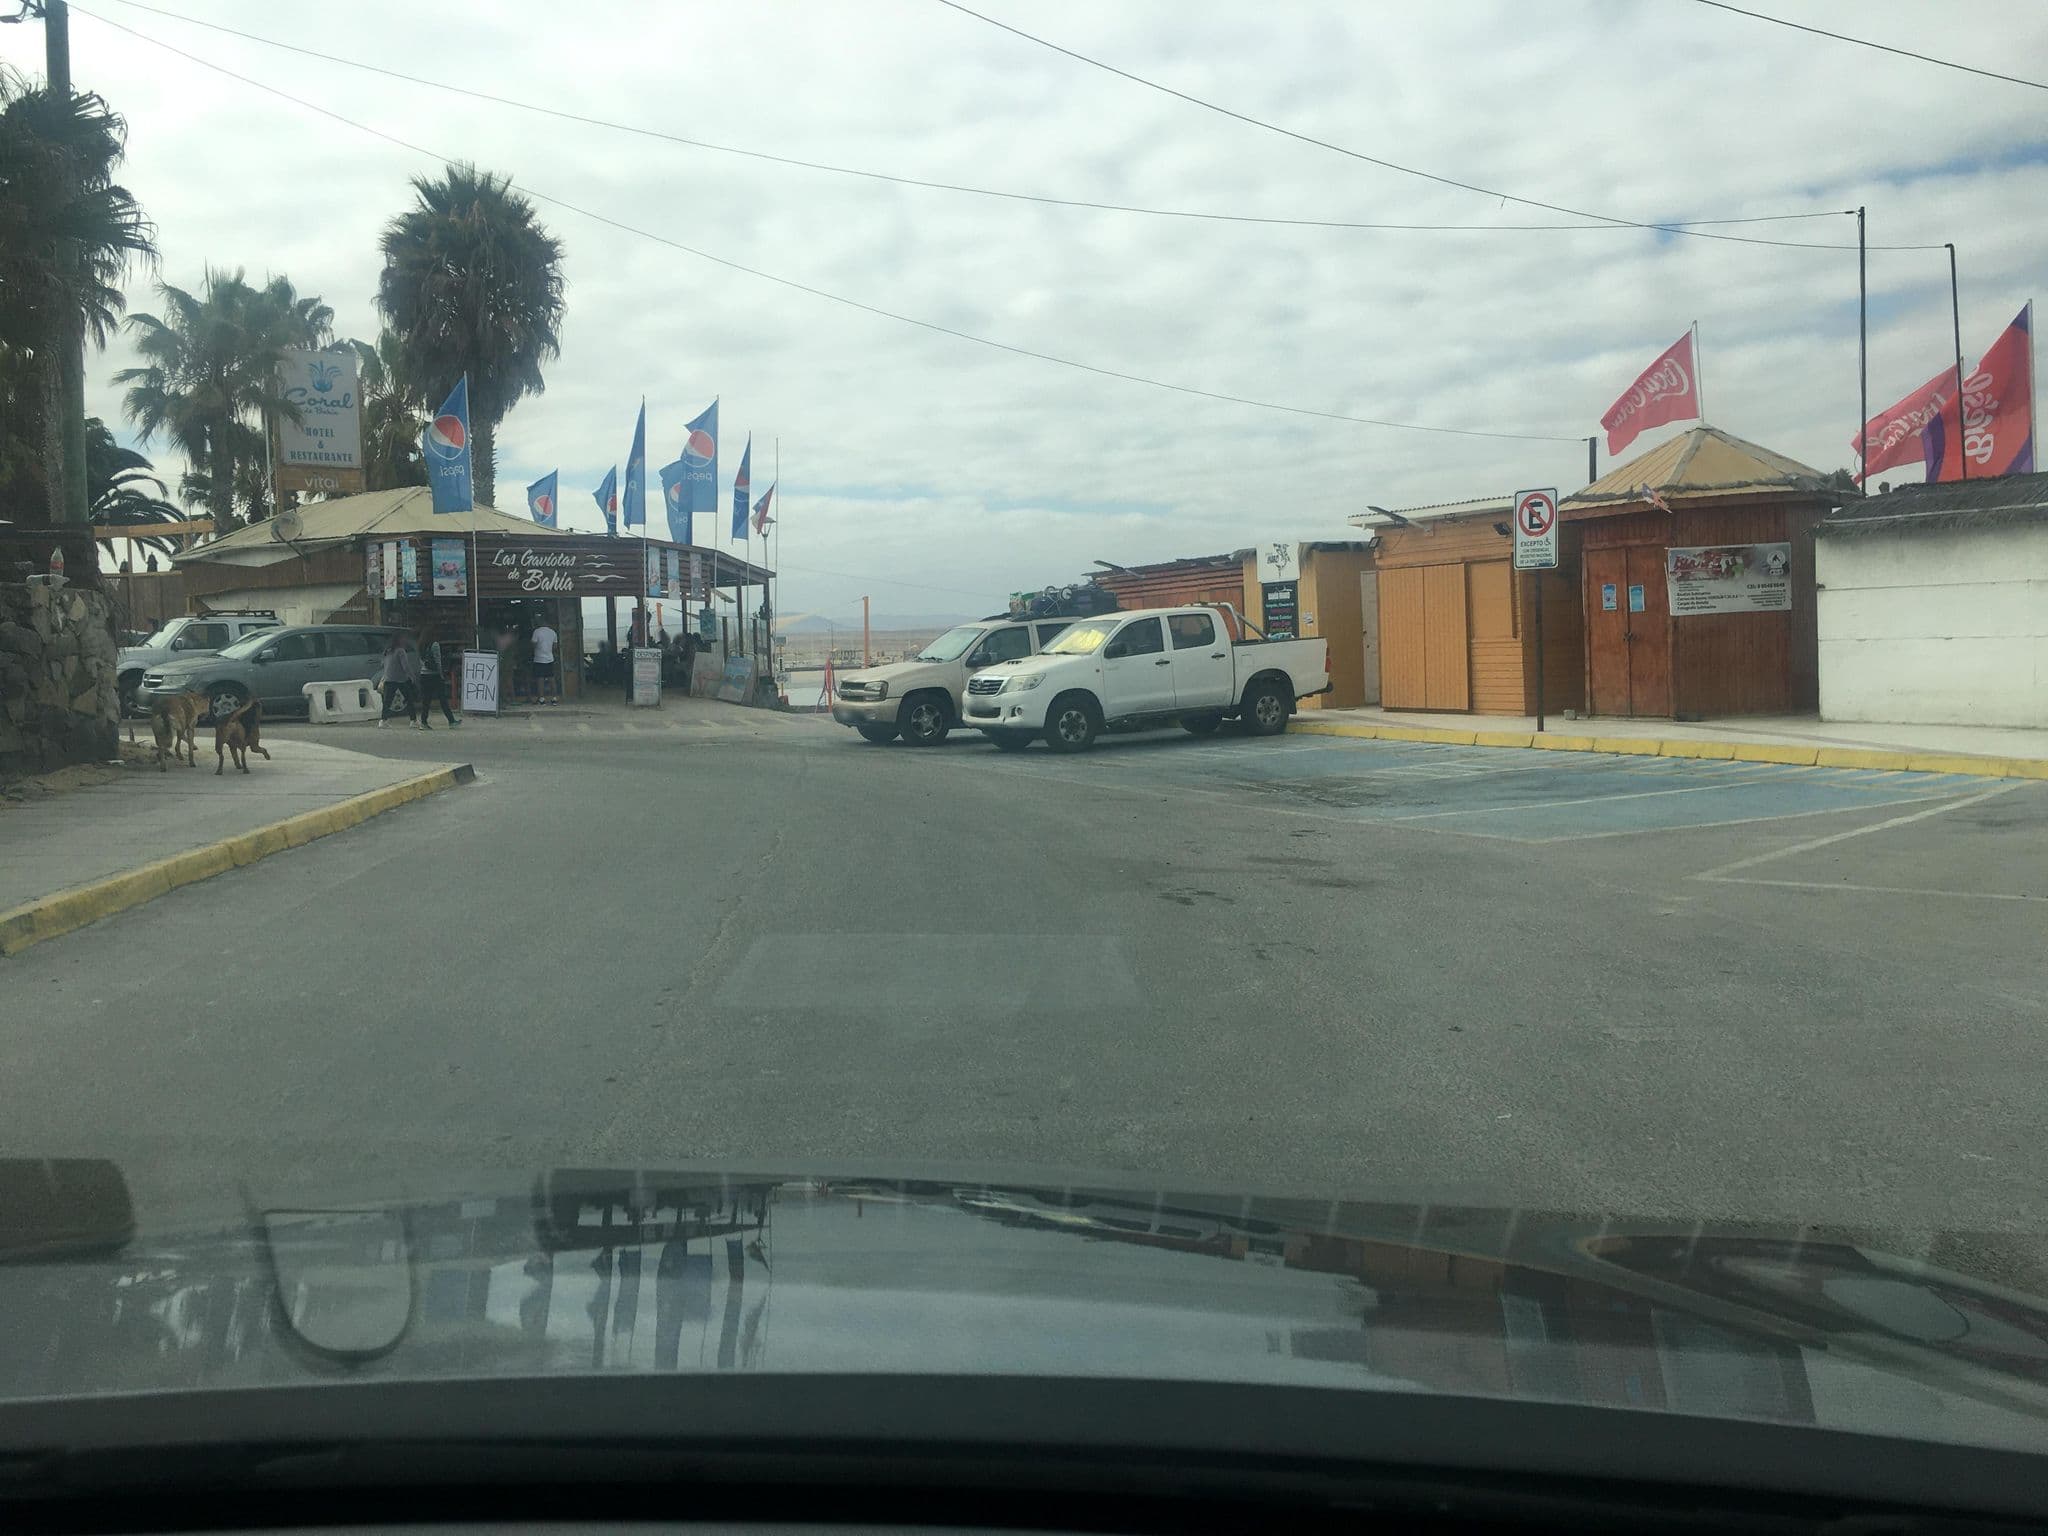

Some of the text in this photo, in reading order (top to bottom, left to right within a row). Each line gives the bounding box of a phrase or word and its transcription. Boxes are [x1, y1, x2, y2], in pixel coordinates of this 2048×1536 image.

[305, 427, 335, 438] HOTEL
[290, 450, 353, 462] RESTAURANTE
[492, 548, 577, 567] Las Gaviotas
[507, 567, 520, 580] de
[465, 662, 496, 681] HAY
[467, 682, 496, 701] PAN
